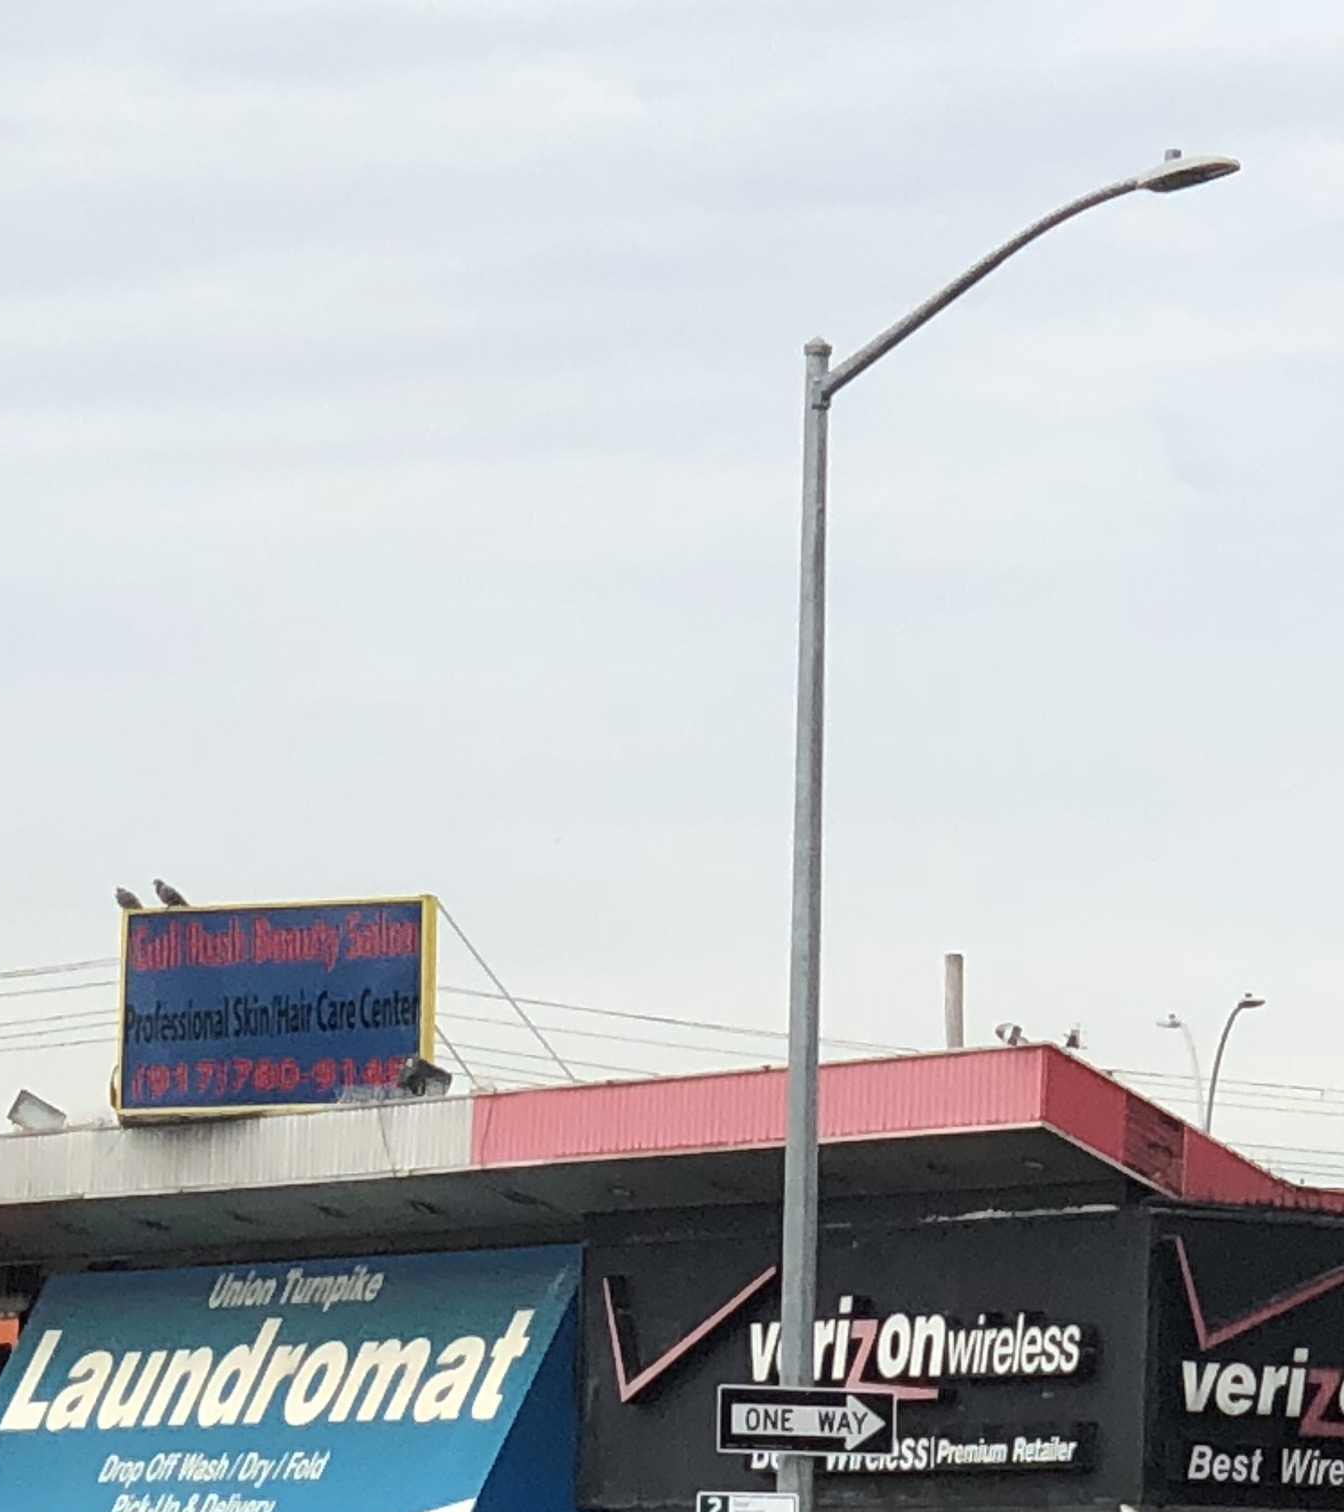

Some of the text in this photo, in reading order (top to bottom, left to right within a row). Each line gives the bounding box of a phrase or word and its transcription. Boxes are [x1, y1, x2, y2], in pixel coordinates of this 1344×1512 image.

[317, 991, 356, 1031] Care
[359, 986, 420, 1029] Center
[209, 1265, 385, 1311] Union Turnpike
[750, 1296, 1081, 1400] vrizon wireless
[0, 1309, 536, 1430] Laundromat
[745, 1409, 869, 1436] ONE WAY
[98, 1454, 144, 1485] Drop
[146, 1453, 178, 1482] Off
[177, 1452, 229, 1482] Wash
[242, 1453, 274, 1489] Dry
[283, 1450, 331, 1480] Fold
[936, 1440, 1007, 1464] Premium
[1012, 1436, 1078, 1463] Retailer
[1188, 1445, 1263, 1483] Best
